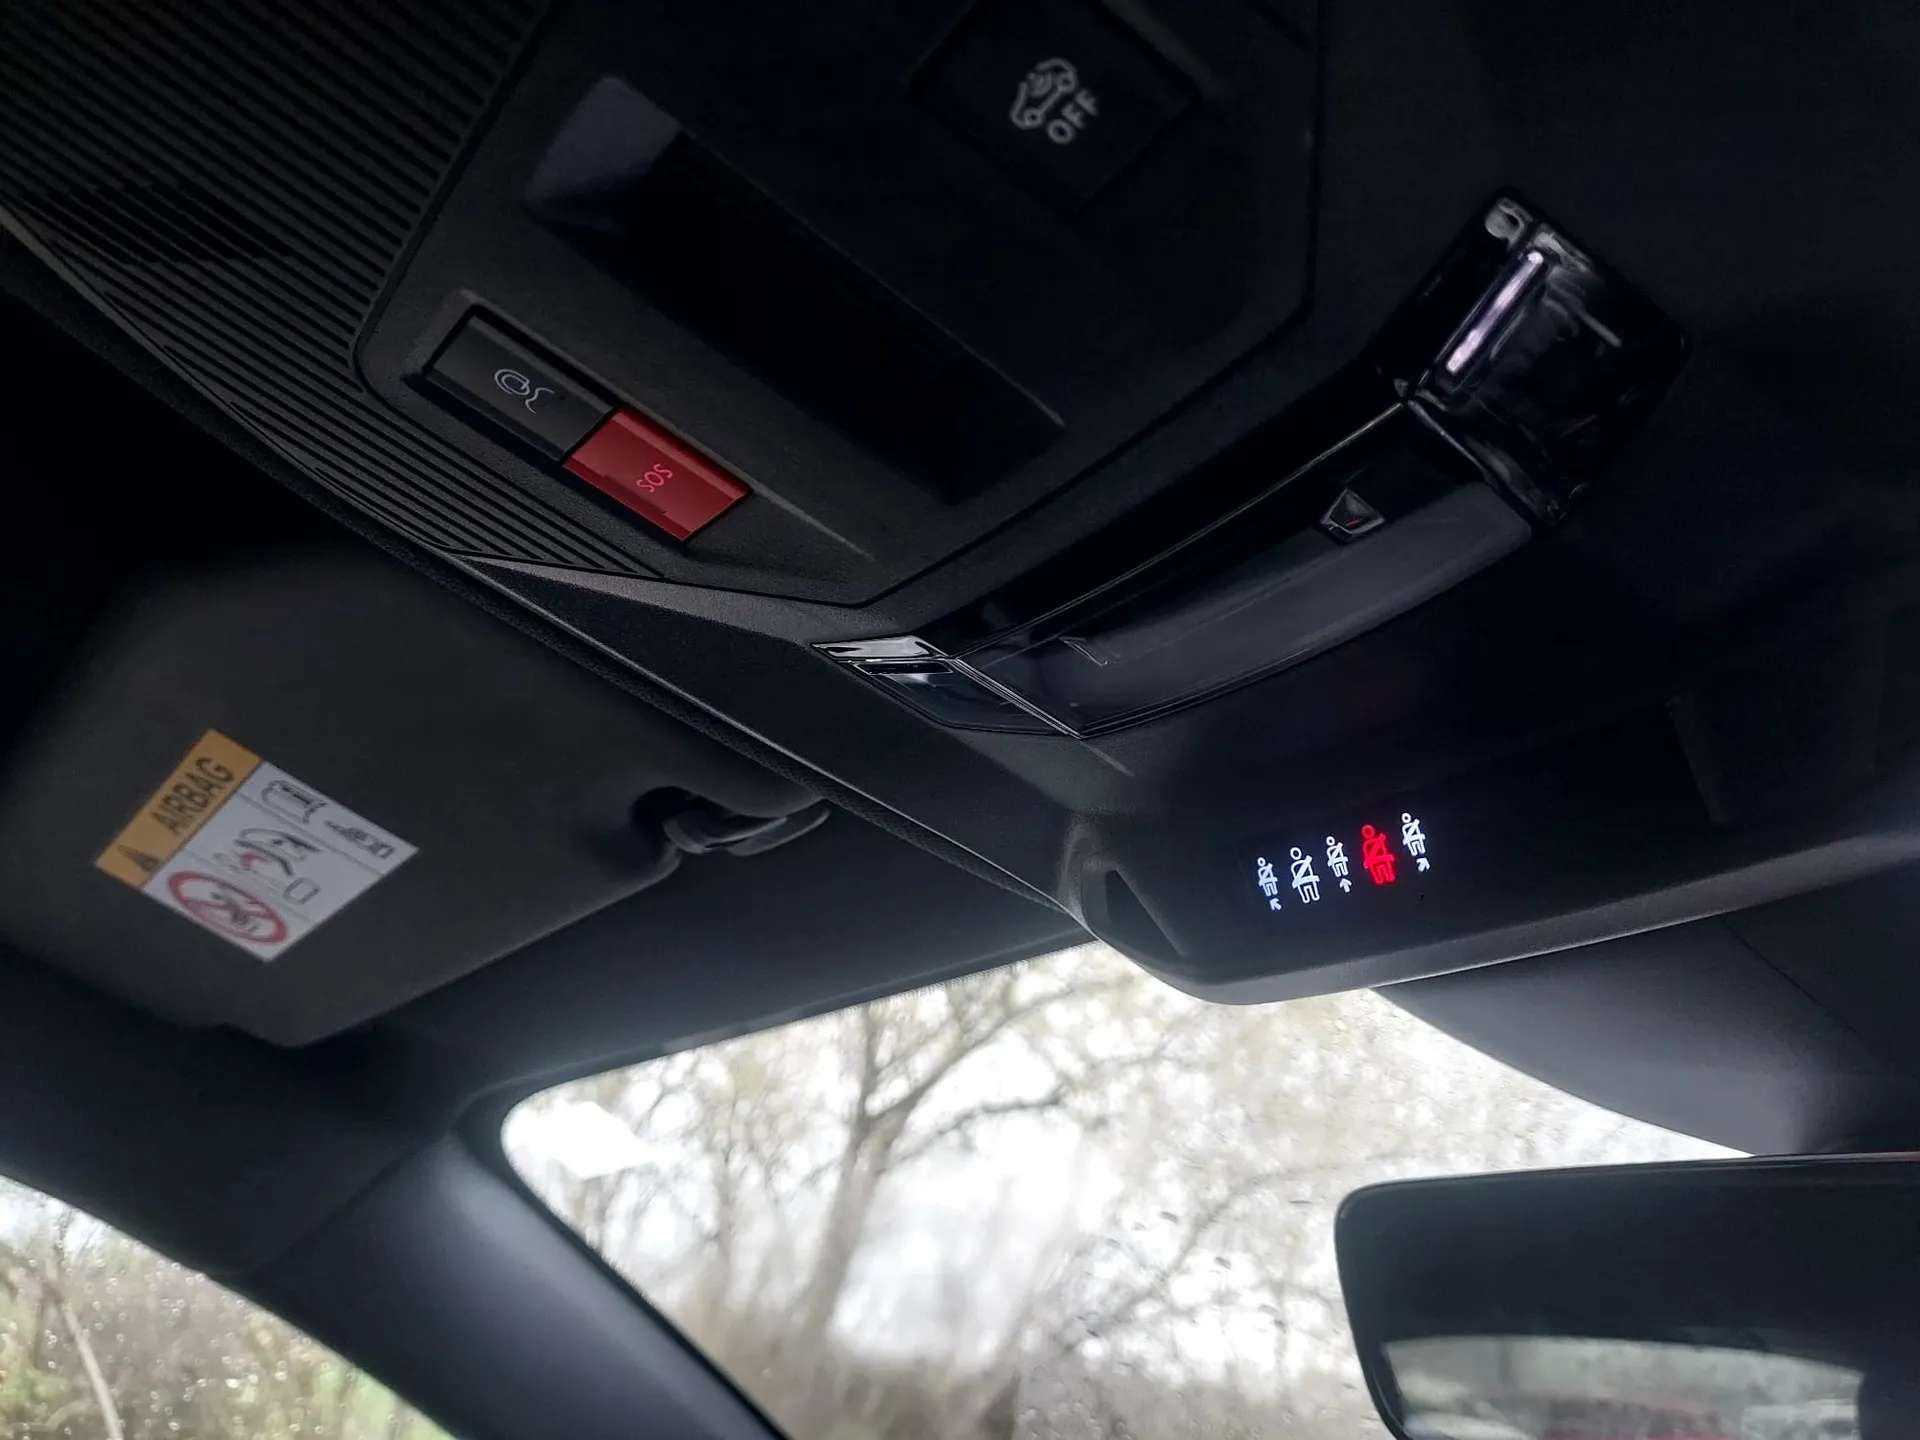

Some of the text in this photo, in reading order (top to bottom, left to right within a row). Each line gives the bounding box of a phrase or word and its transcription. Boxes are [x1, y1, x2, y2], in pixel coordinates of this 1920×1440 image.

[1047, 89, 1098, 143] OFF
[636, 463, 673, 493] SOS
[152, 757, 235, 834] AIRBAG
